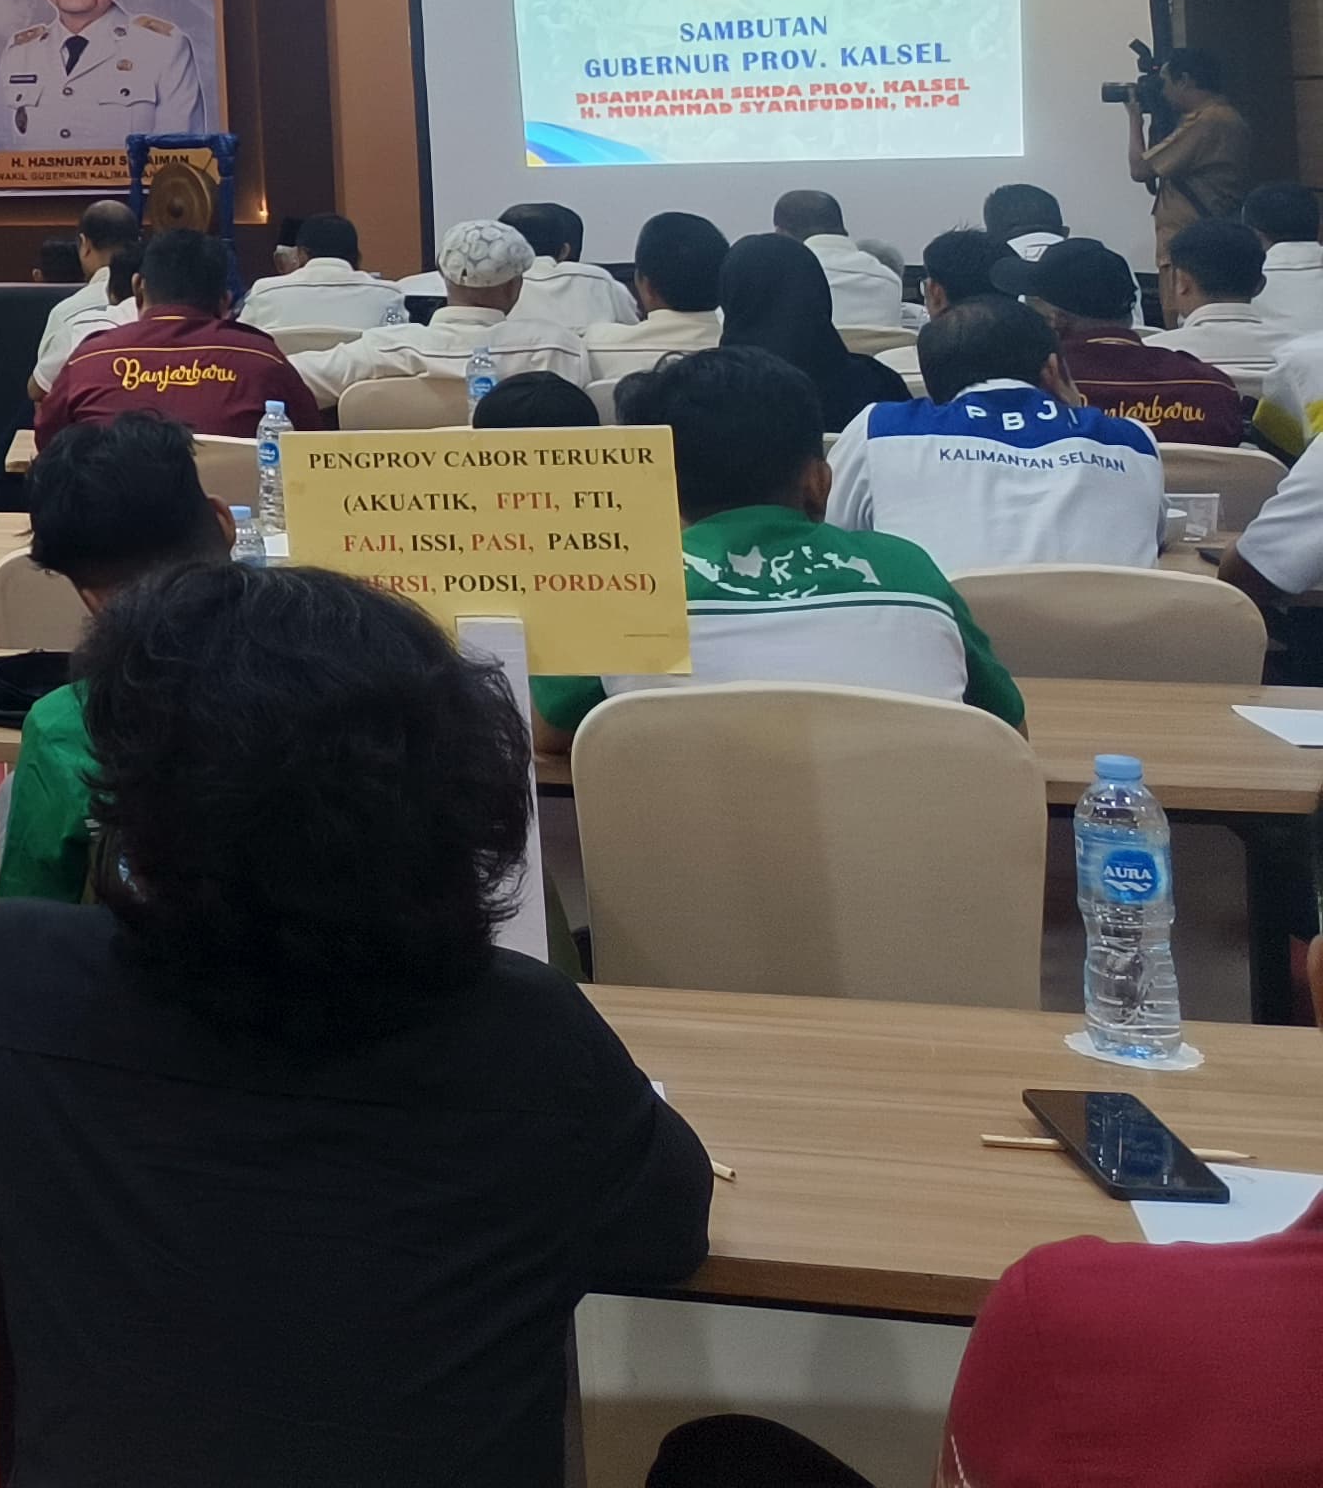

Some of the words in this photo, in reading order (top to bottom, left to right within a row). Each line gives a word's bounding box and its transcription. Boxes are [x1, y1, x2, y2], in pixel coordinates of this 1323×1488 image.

[679, 15, 828, 43] SAMBUTAN
[584, 53, 730, 78] GUBERNUR
[742, 49, 827, 72] PROV.
[840, 43, 951, 67] KALSEL
[575, 87, 724, 105] DISAMPAIKAN
[731, 84, 802, 99] SEKDA
[809, 81, 876, 96] PROV.
[883, 78, 970, 93] KALSEL
[580, 107, 601, 119] H.
[607, 102, 733, 118] MUHAMMAD
[740, 97, 897, 114] SYARIFUDDIN,
[904, 94, 961, 108] M.Pd
[11, 158, 24, 168] H.
[28, 156, 115, 167] HASNURYADI
[113, 357, 237, 392] Banjarbaru
[308, 450, 438, 470] PENGPROV
[444, 449, 529, 468] CABOR
[534, 447, 655, 466] TERUKUR
[939, 448, 1054, 469] KALIMANTAN
[1059, 451, 1126, 473] SELATAN
[343, 492, 477, 514] (AKUATIK,
[496, 491, 559, 511] FPTI,
[573, 491, 622, 511] FTI,
[342, 534, 404, 554] FAJI,
[411, 533, 464, 554] ISSI,
[471, 533, 534, 554] PASI,
[547, 532, 629, 553] PABSI,
[443, 574, 527, 594] PODSI,
[533, 573, 657, 595] PORDASI)
[1103, 865, 1153, 880] AURA
